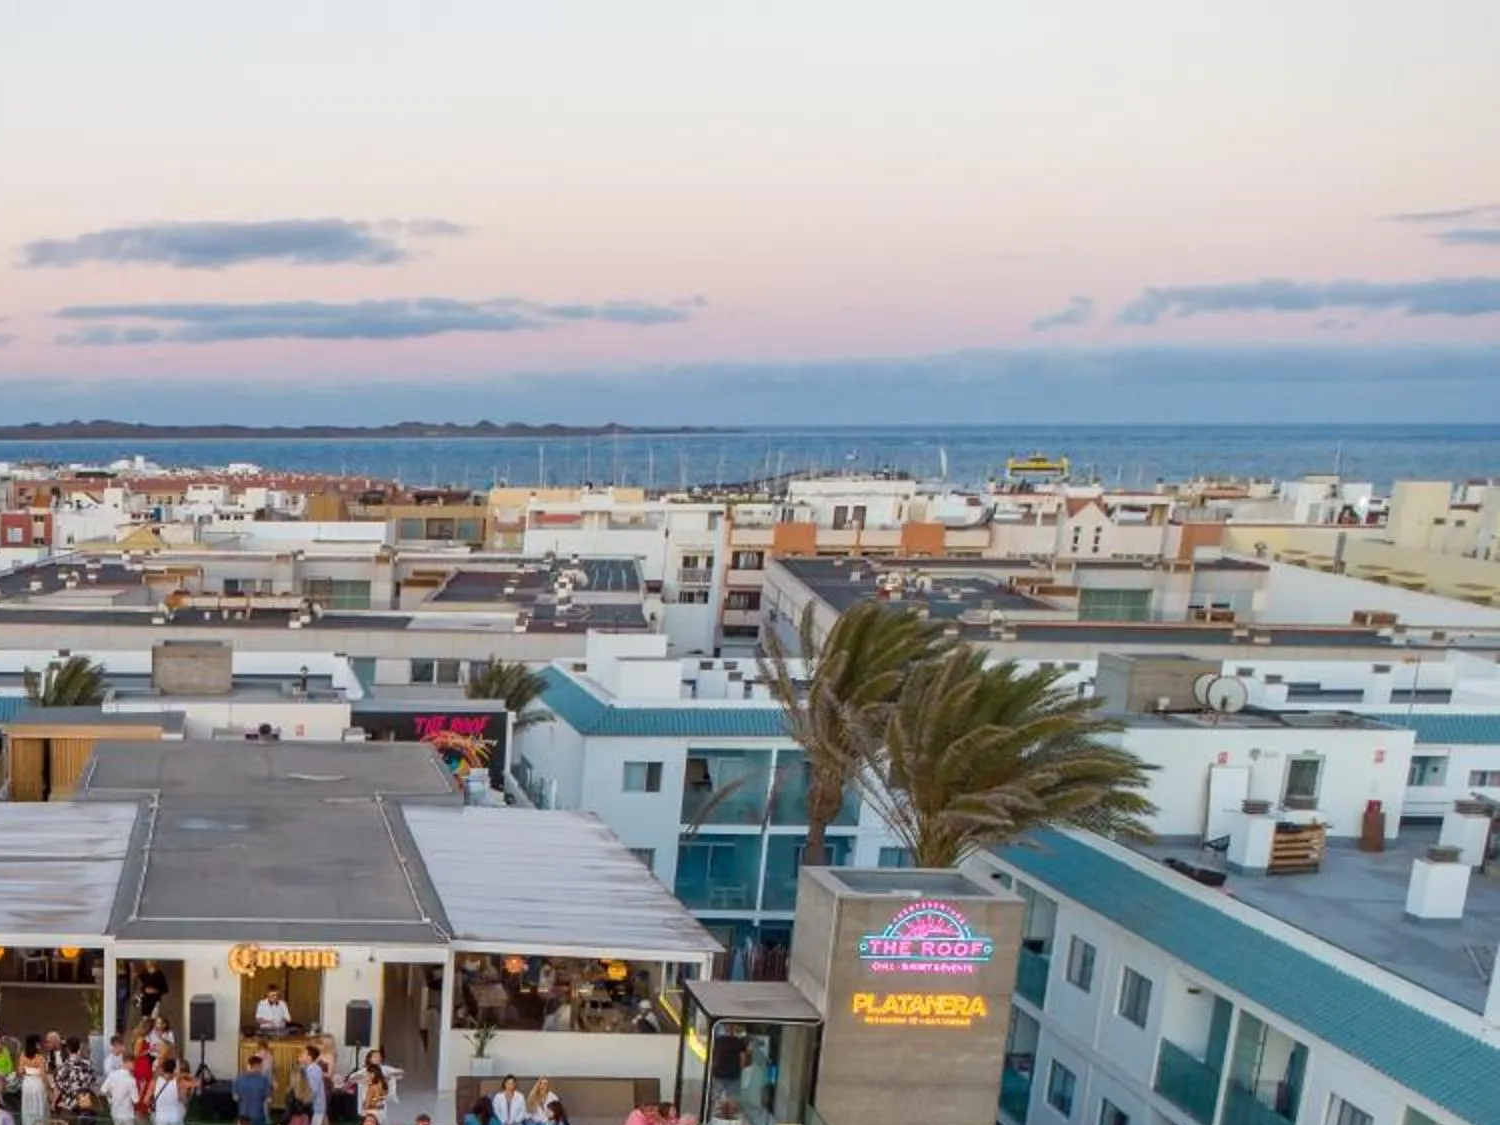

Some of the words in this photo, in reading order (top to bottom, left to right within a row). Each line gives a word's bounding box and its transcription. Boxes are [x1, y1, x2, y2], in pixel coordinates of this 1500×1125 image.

[868, 939, 913, 955] THE
[920, 941, 985, 957] ROOF
[852, 992, 988, 1017] PLATANERA
